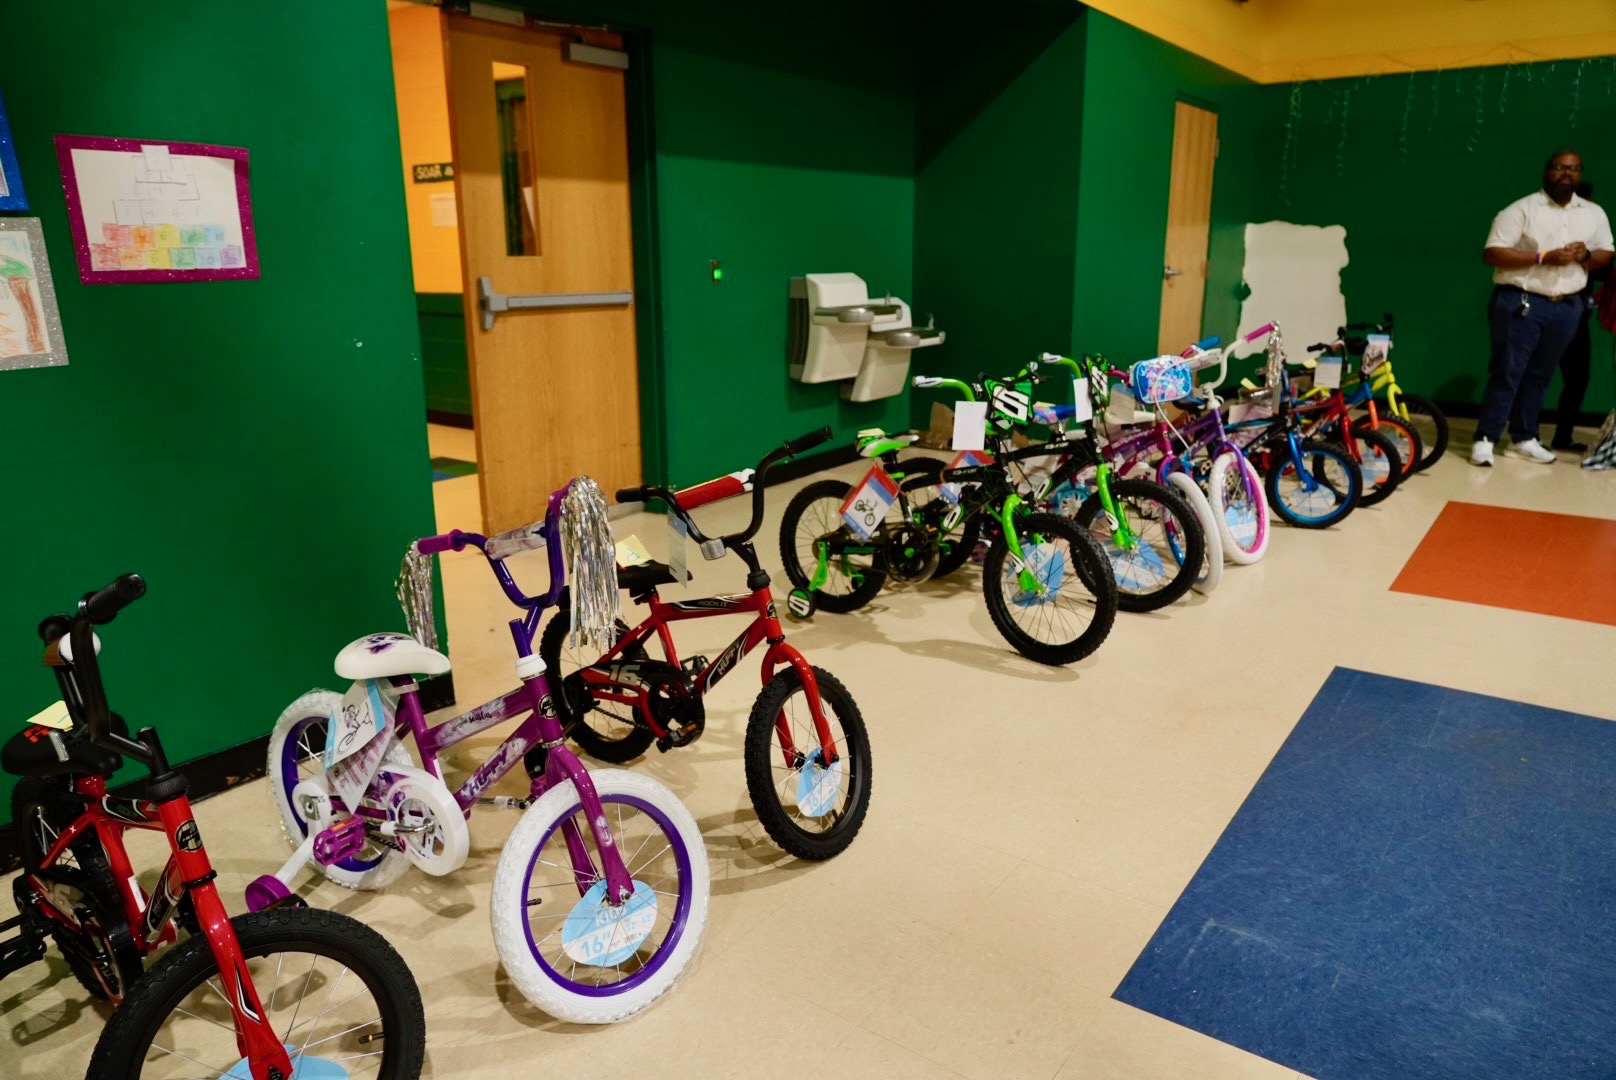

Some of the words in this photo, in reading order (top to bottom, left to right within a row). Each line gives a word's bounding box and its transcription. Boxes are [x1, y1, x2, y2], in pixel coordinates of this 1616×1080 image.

[609, 664, 641, 686] 16
[469, 747, 508, 796] HUFFY
[581, 931, 611, 958] 16"
